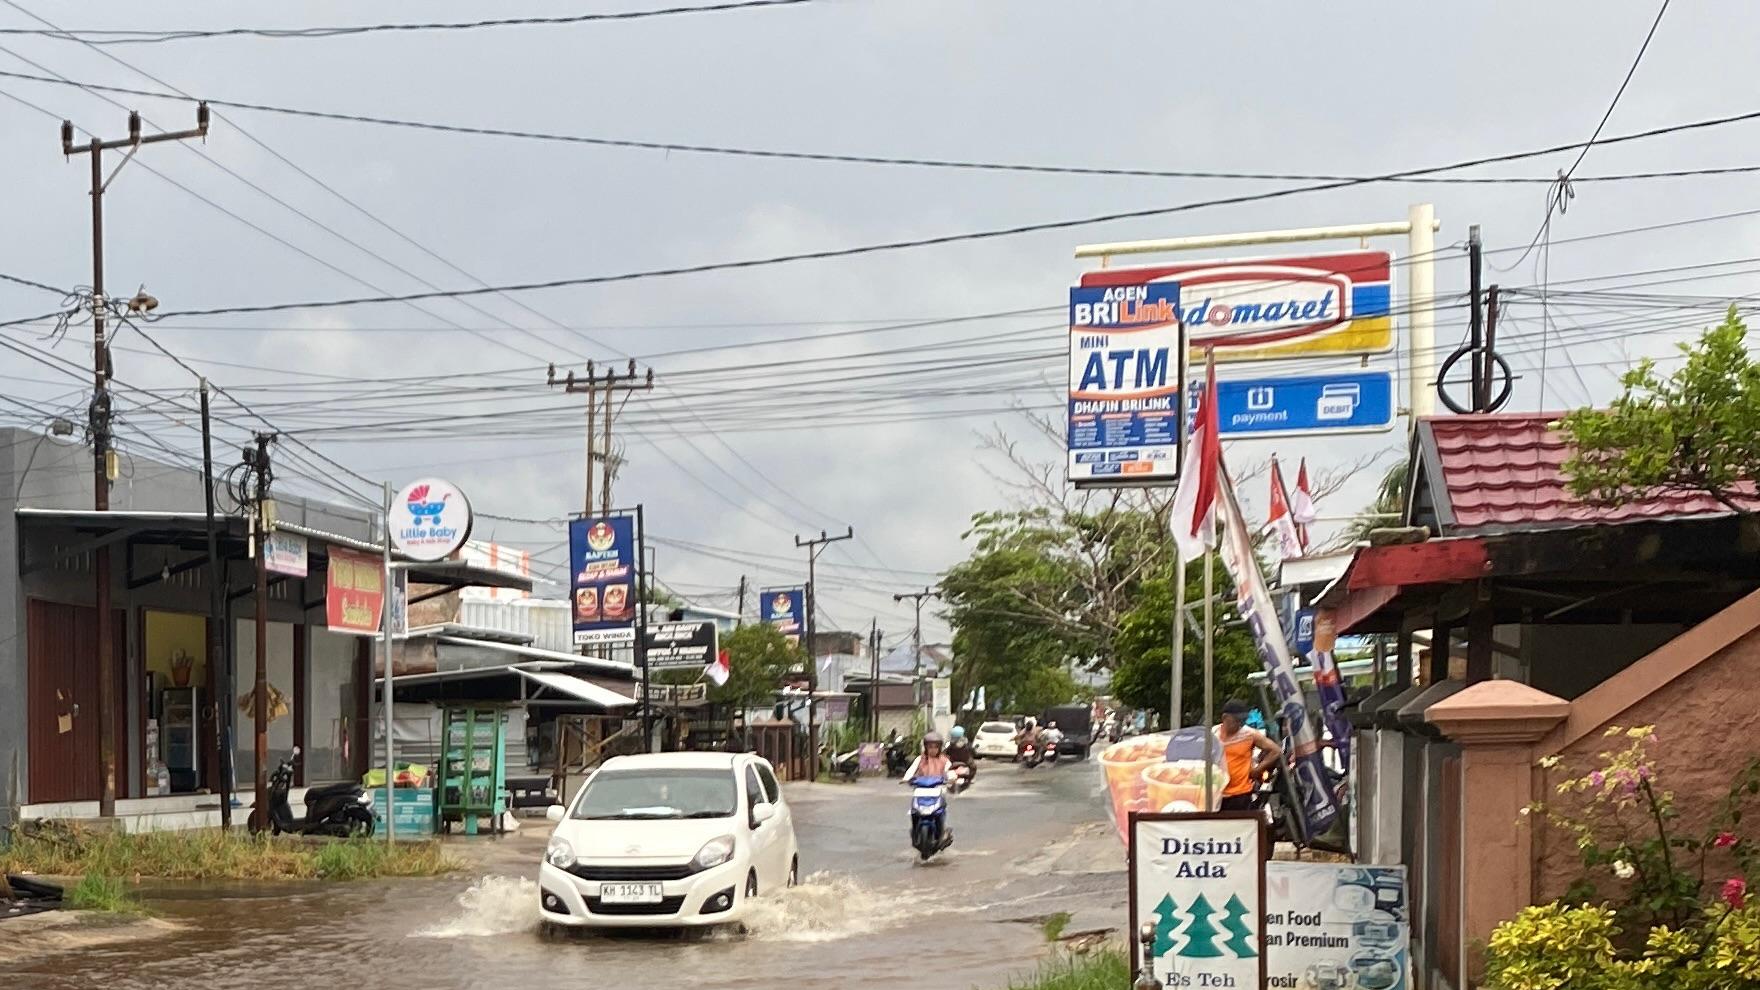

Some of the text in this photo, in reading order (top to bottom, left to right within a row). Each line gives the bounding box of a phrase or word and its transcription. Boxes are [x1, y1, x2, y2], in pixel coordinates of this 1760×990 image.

[1103, 286, 1147, 301] AGEN
[1075, 298, 1176, 325] BRILink
[1080, 335, 1109, 349] MINI
[1078, 348, 1169, 391] ATM
[1074, 397, 1171, 413] DHAFIN BRILINK
[1323, 405, 1351, 414] DEBIT
[1232, 410, 1288, 425] payment
[400, 527, 457, 539] Little Baby
[1161, 836, 1243, 855] Disini
[1176, 860, 1227, 879] Ada
[1287, 911, 1321, 926] Food
[1287, 932, 1349, 948] Premium
[1165, 972, 1235, 987] Es Teh
